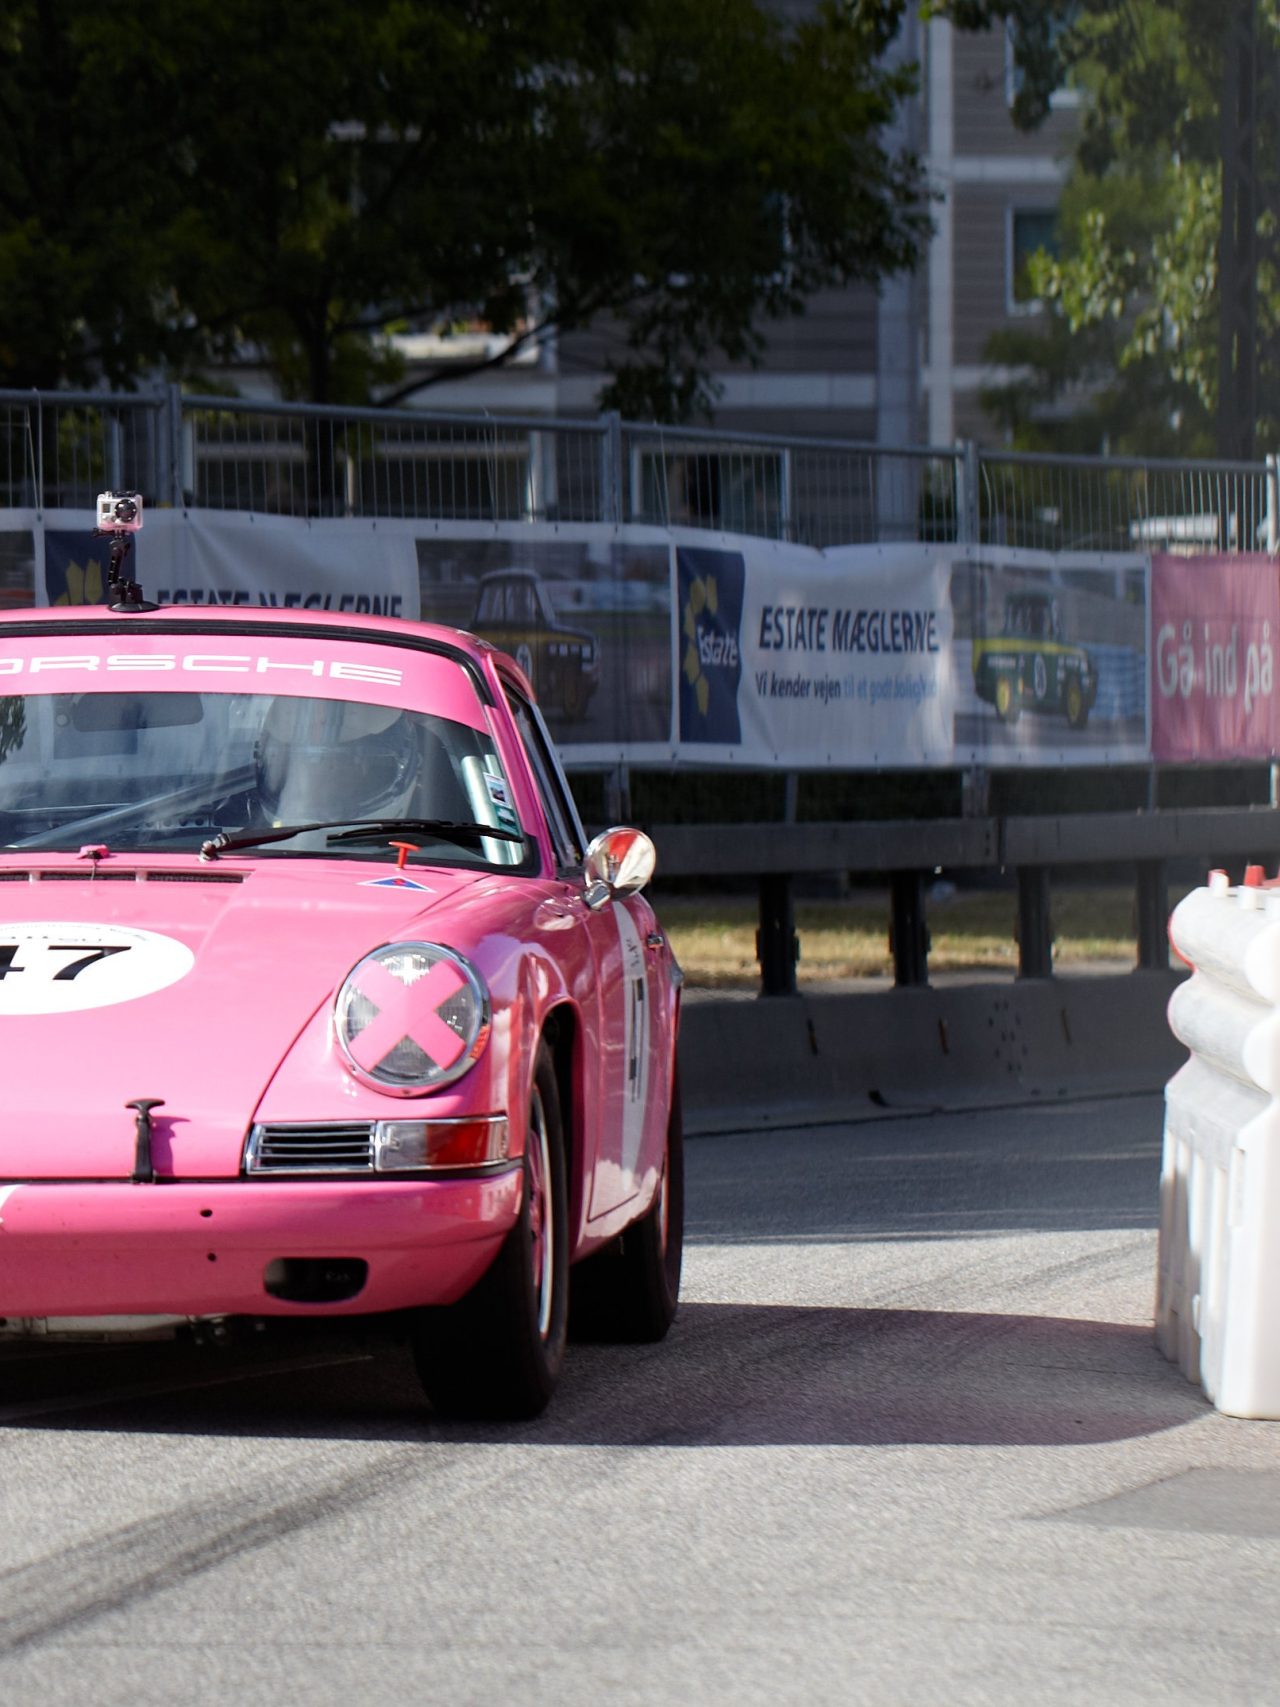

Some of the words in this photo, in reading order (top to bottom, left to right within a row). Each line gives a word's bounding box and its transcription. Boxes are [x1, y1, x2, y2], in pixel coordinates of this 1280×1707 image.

[759, 605, 828, 651] ESTATE
[832, 609, 940, 652] MÆGLERNE
[756, 671, 768, 696] Vi
[771, 672, 811, 698] kender
[814, 673, 841, 705] vejen
[1204, 622, 1238, 698] ind
[1244, 619, 1273, 716] på
